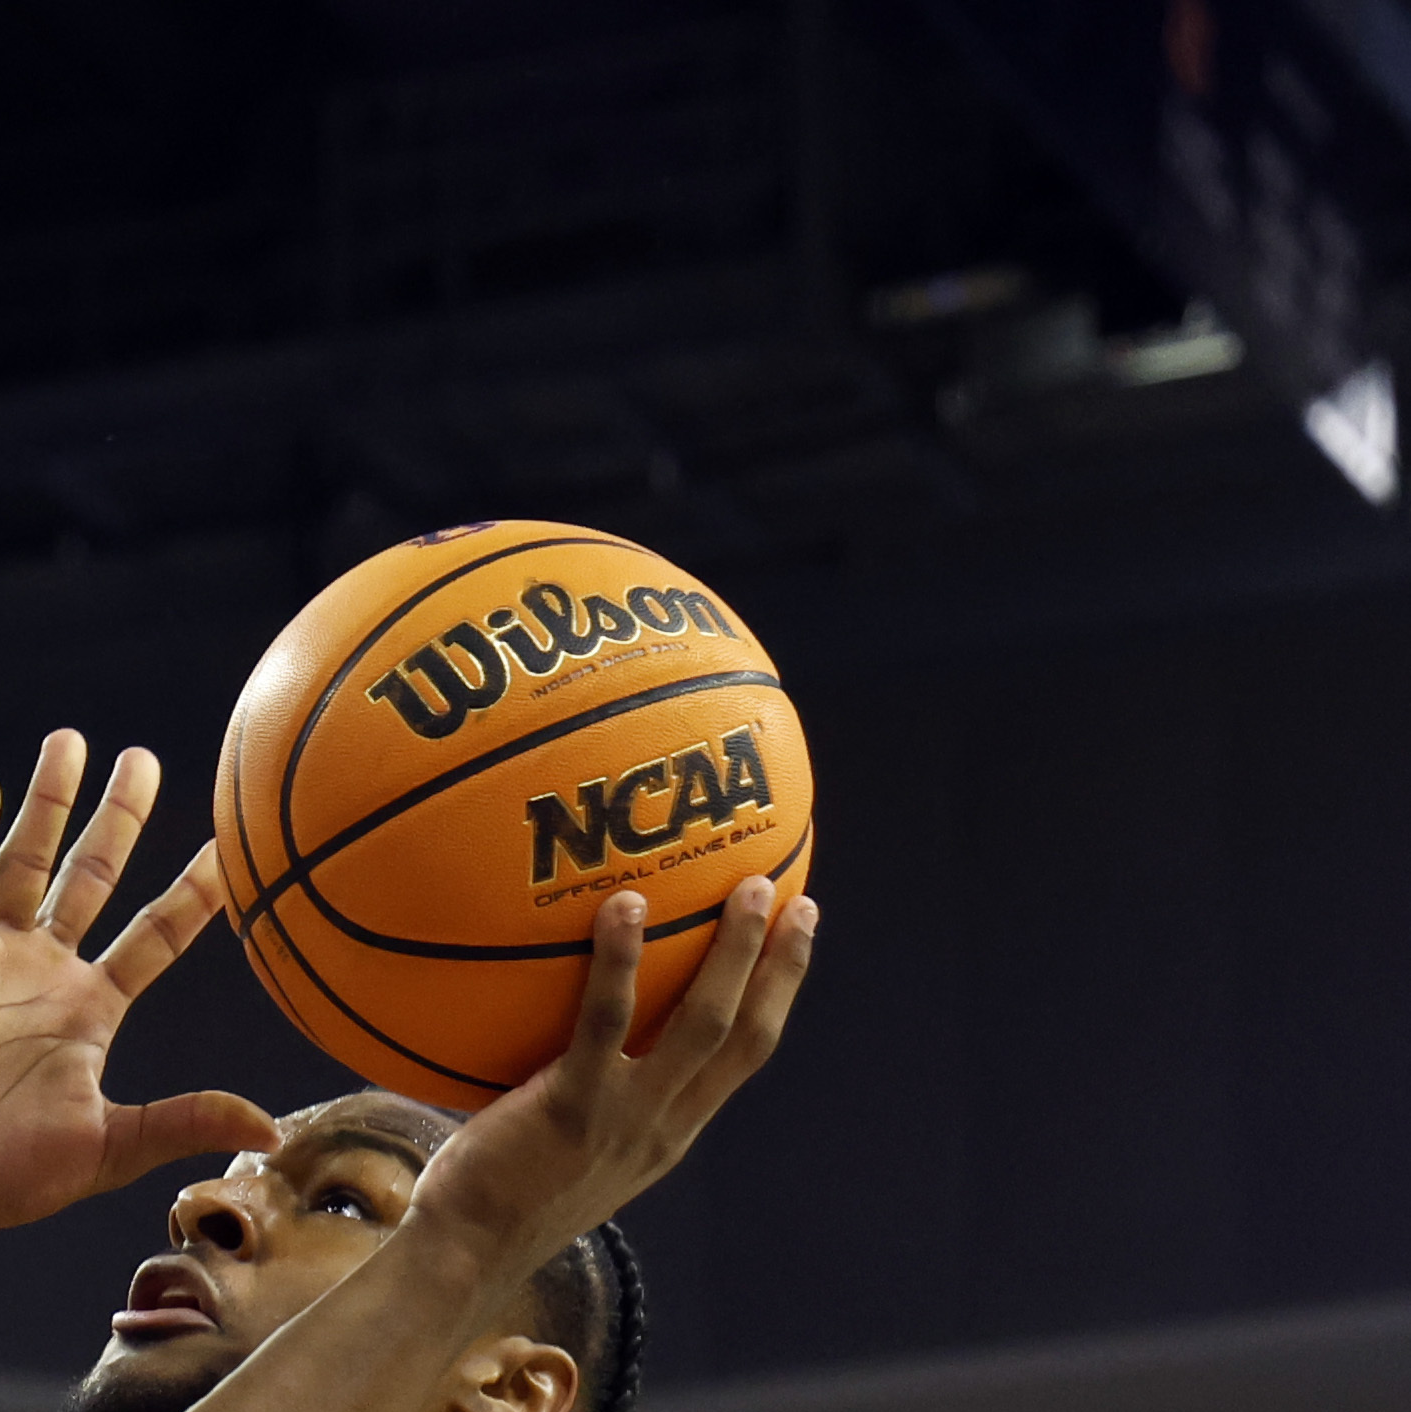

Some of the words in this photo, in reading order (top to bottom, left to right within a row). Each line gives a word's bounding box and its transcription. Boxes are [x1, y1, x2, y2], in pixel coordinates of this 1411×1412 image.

[364, 580, 747, 740] Wilson
[530, 664, 596, 700] INDOOR
[522, 722, 775, 887] NCAA
[534, 867, 654, 908] OFFICIAL
[659, 838, 727, 871] GAME
[729, 818, 777, 845] BALL
